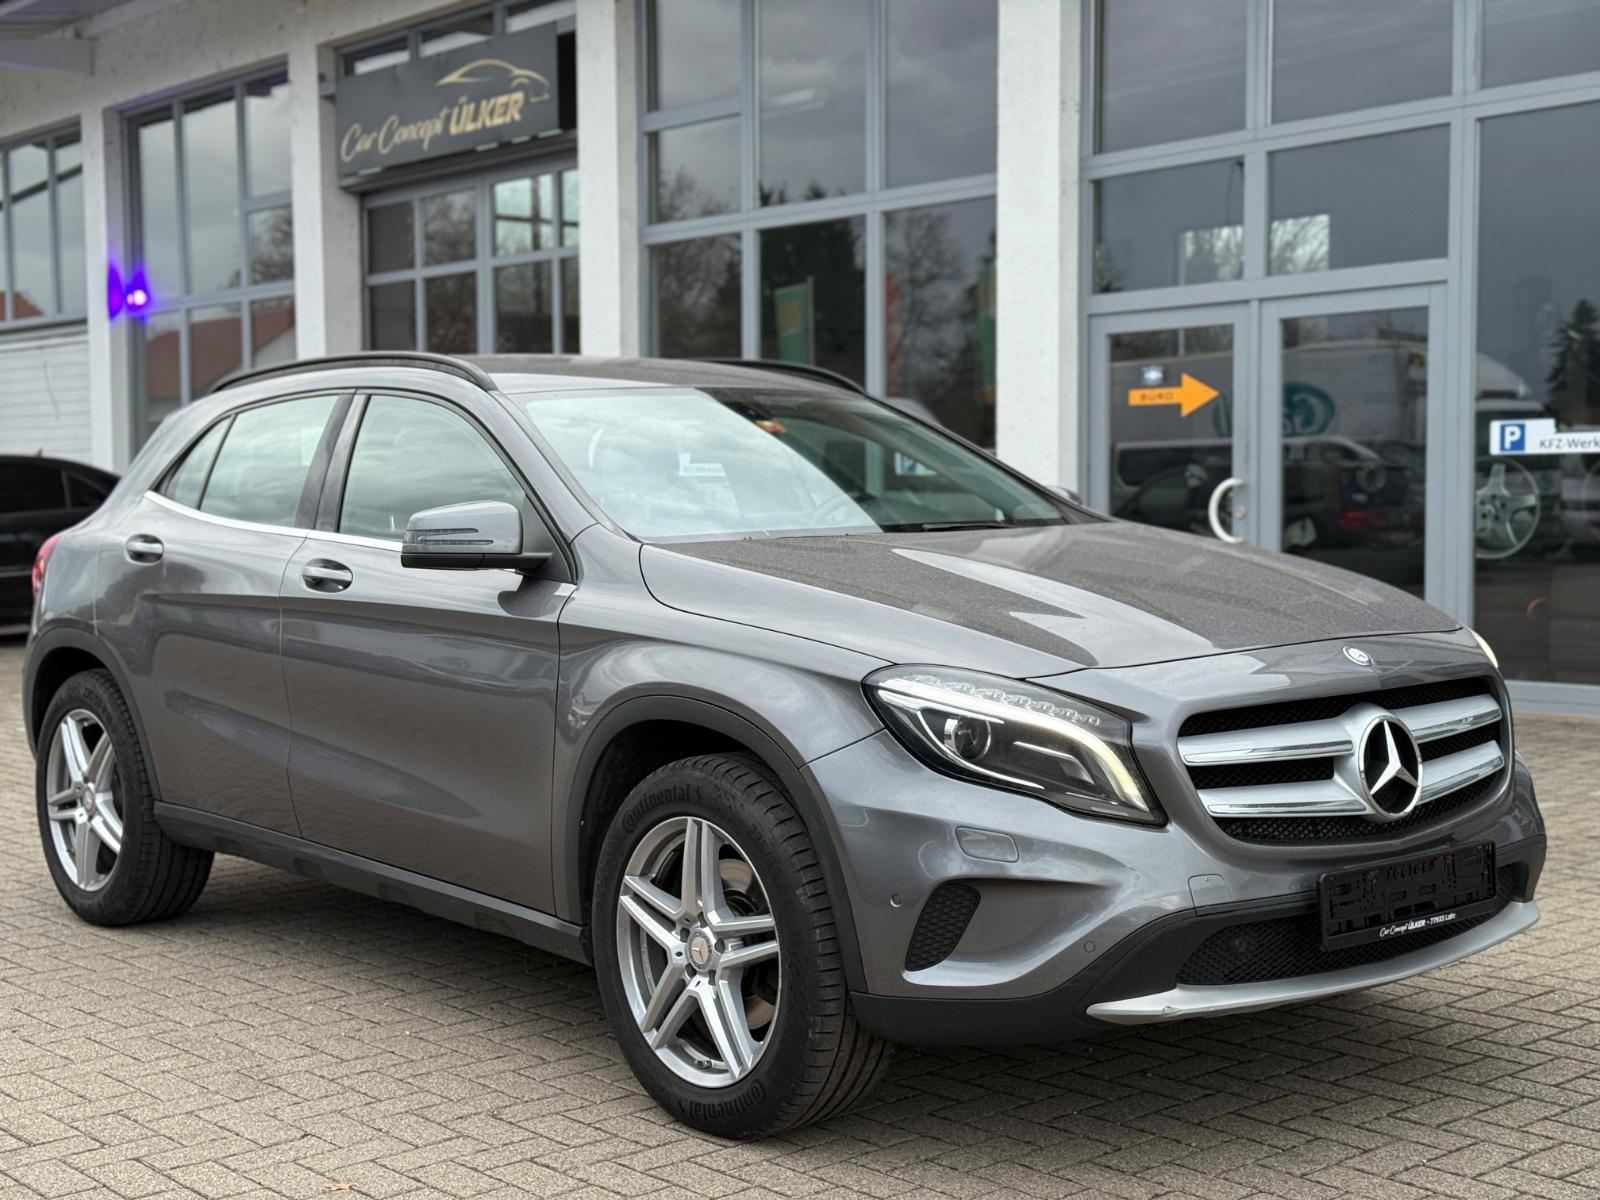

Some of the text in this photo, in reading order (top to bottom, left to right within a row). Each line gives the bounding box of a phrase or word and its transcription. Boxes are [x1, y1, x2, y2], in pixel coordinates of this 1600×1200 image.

[340, 91, 525, 162] Car Concept ÜLKER
[1504, 425, 1521, 450] P
[622, 783, 691, 834] Continental
